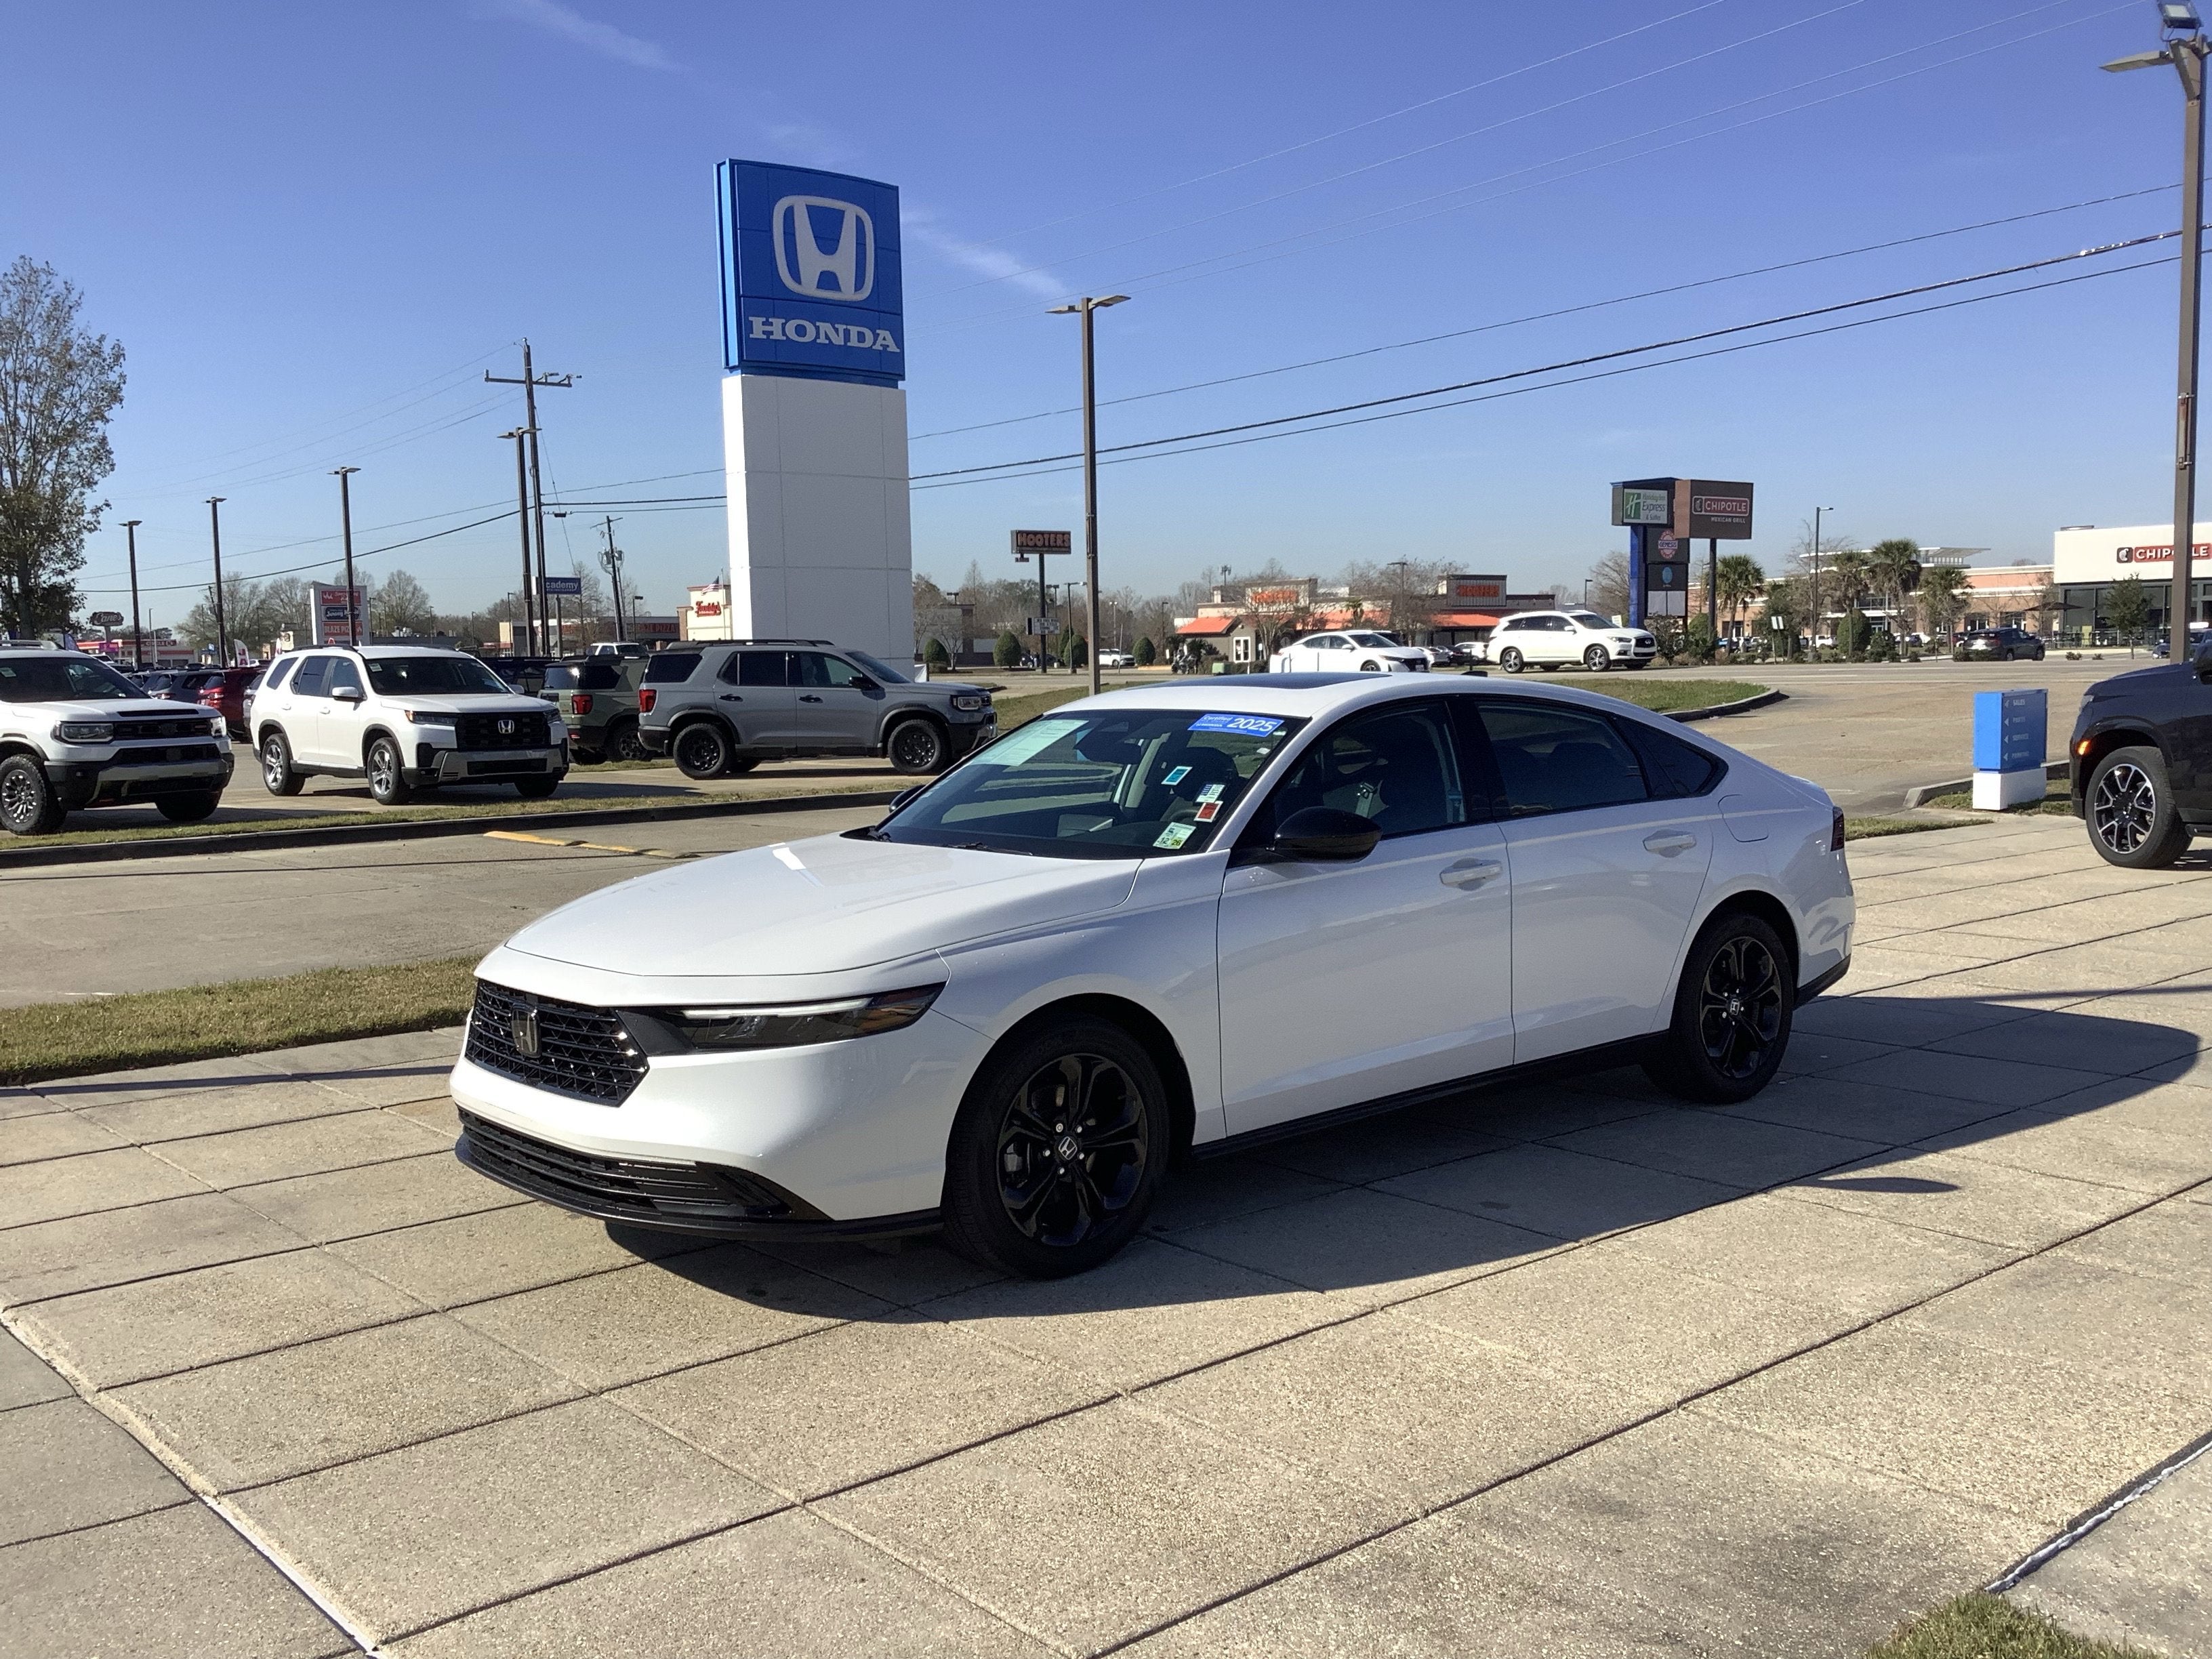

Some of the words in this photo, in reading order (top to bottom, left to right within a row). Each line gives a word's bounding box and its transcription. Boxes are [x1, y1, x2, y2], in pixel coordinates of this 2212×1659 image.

[749, 316, 901, 352] HONDA
[1642, 501, 1666, 514] Express
[1705, 501, 1746, 512] CHIPOTLE
[1018, 533, 1069, 547] HOOTERS
[2136, 546, 2209, 559] CHIPLE
[546, 581, 579, 591] cademy
[1227, 718, 1277, 731] 2025
